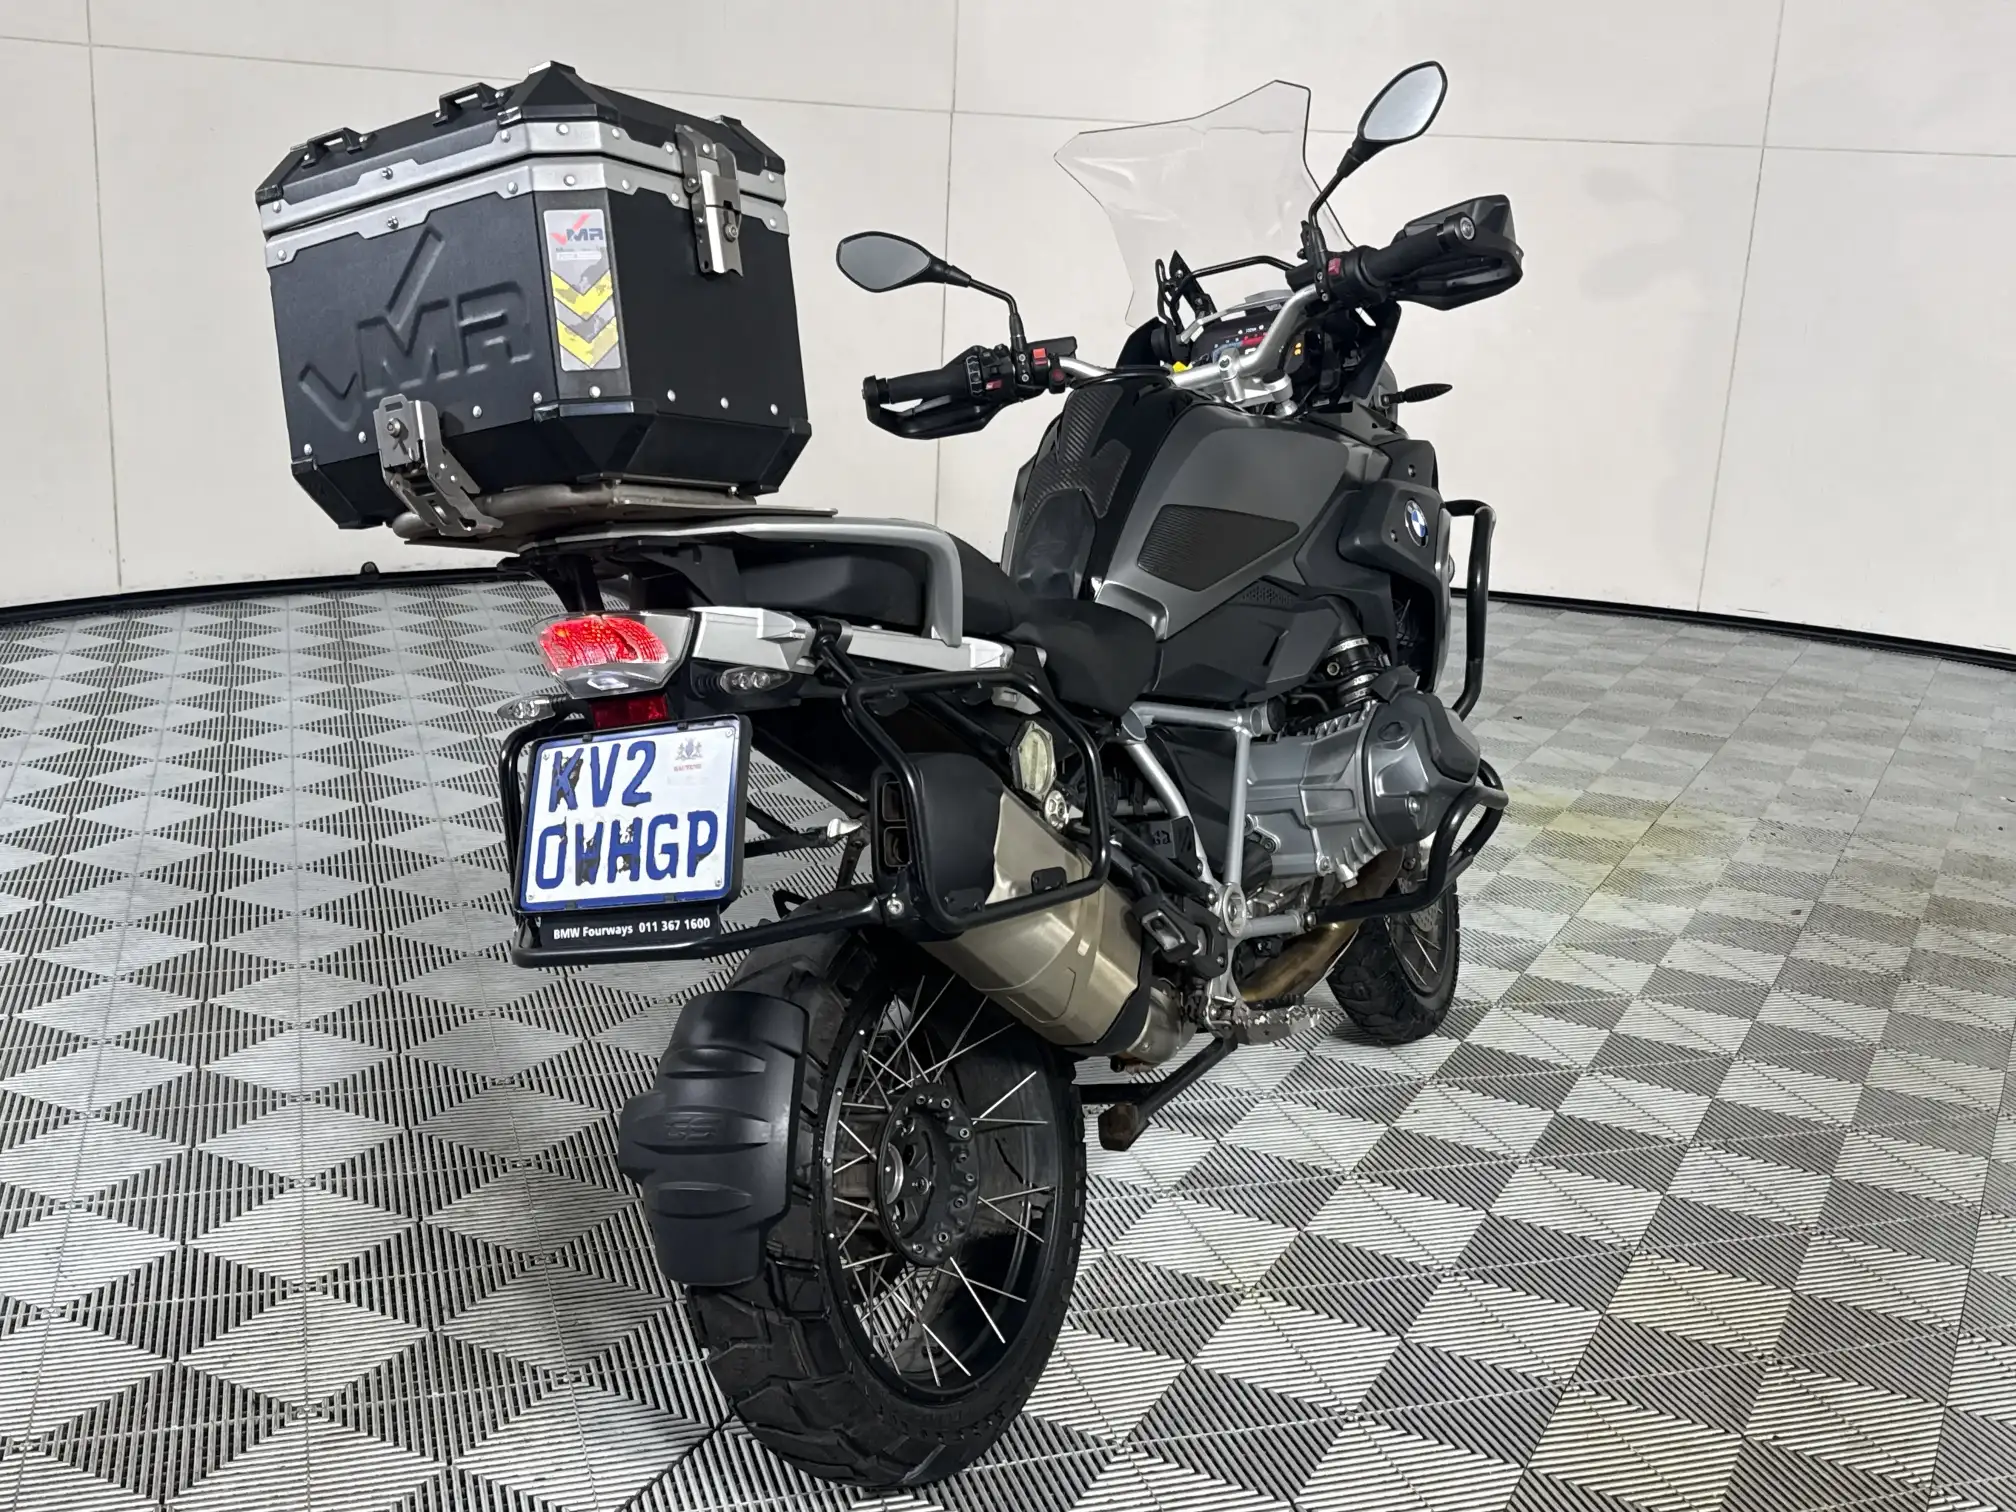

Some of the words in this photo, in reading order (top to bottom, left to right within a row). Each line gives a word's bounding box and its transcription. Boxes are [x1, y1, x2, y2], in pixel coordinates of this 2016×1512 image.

[549, 740, 656, 812] KV2
[553, 928, 580, 940] BMW
[582, 924, 633, 938] Fourways
[638, 922, 658, 933] 011
[661, 920, 681, 931] 367
[684, 917, 711, 930] 1600
